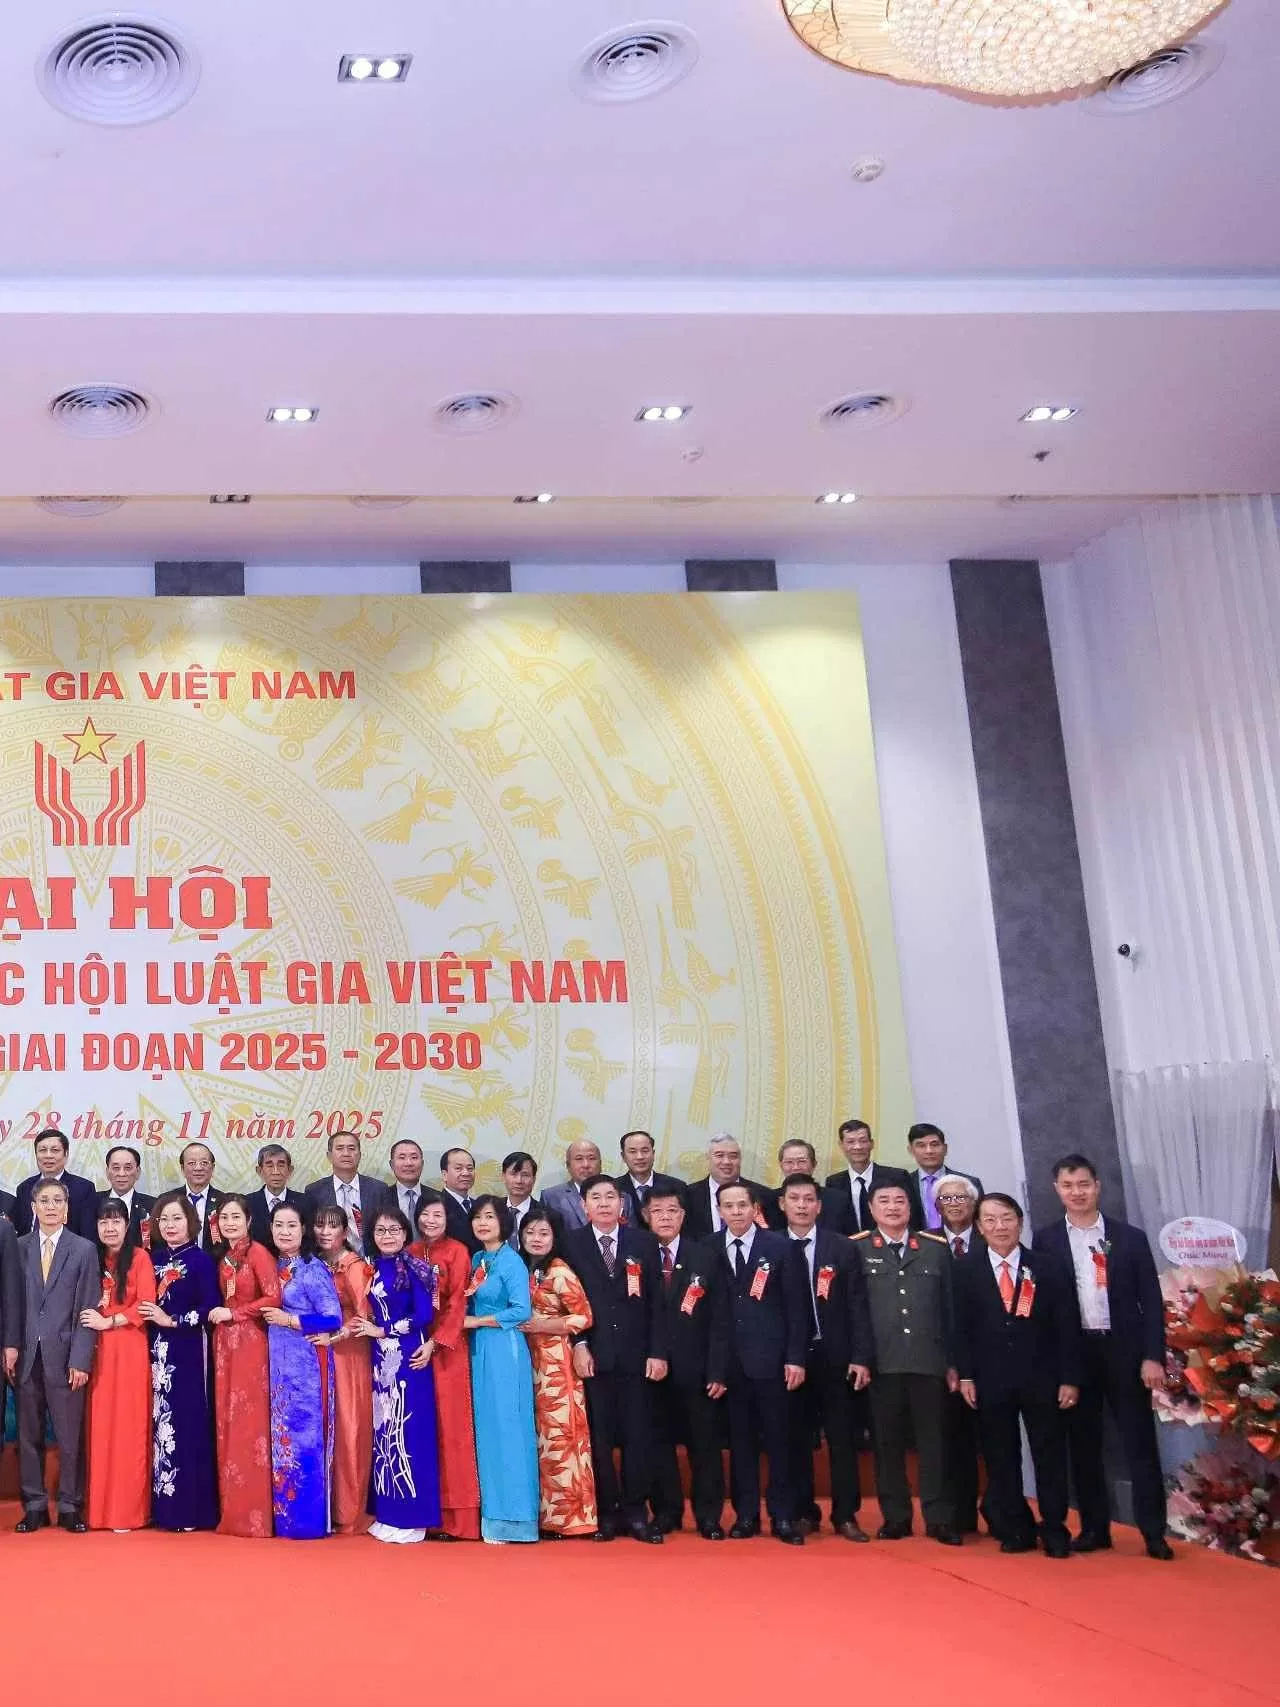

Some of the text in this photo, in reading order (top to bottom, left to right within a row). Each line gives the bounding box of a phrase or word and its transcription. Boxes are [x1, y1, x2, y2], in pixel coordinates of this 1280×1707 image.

[46, 671, 123, 700] GIA
[139, 664, 236, 709] VIỆT
[252, 671, 356, 700] NAM
[109, 865, 273, 940] HỘI
[44, 952, 127, 1015] HỘI
[147, 952, 268, 1014] LUẬT
[286, 960, 371, 1005] GIA
[386, 951, 493, 1013] VIỆT
[510, 960, 628, 1004] NAM
[81, 1033, 204, 1080] ĐOẠN
[219, 1032, 326, 1071] 2025
[374, 1032, 482, 1071] 2030
[22, 1111, 64, 1139] 28
[72, 1111, 165, 1147] tháng
[176, 1111, 213, 1139] 11
[225, 1112, 296, 1139] năm
[305, 1110, 384, 1139] 2025
